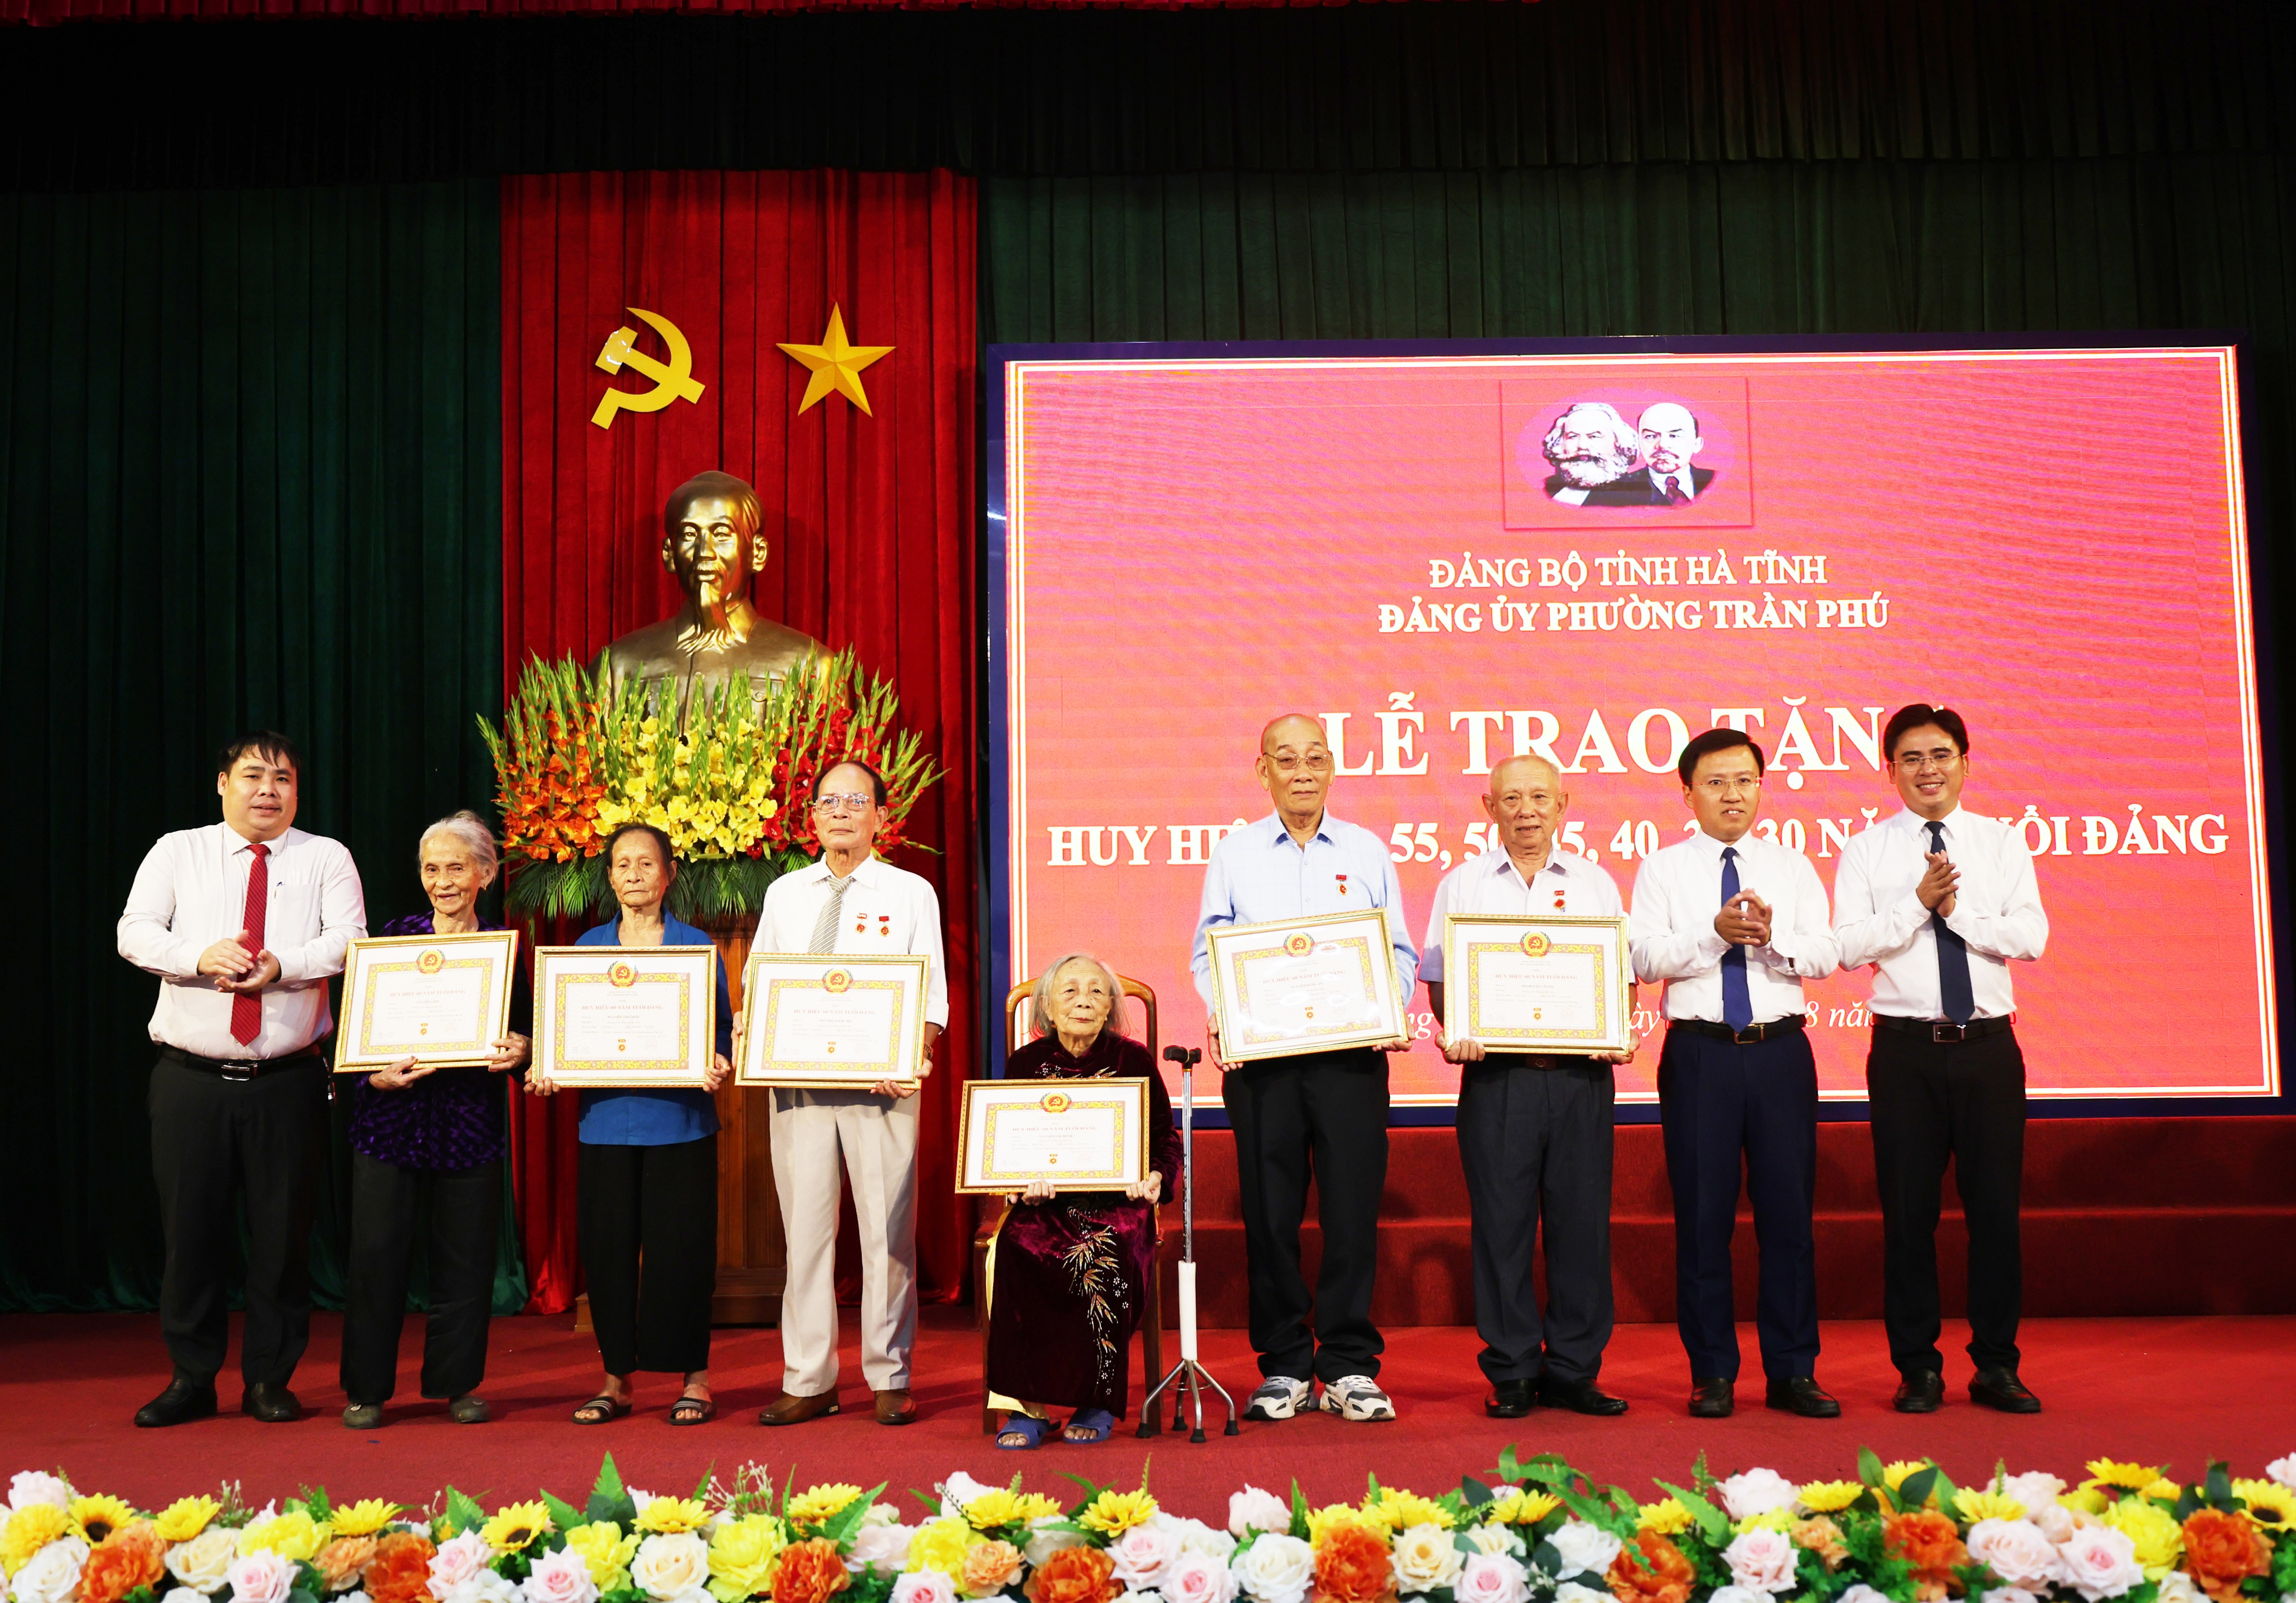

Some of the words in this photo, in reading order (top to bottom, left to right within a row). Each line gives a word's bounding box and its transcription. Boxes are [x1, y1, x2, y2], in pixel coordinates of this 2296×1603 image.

[1429, 551, 1531, 588] ĐẢNG
[1537, 550, 1588, 592] BỘ
[1595, 549, 1679, 586] TỈNH
[1685, 549, 1738, 585] HÀ
[1743, 549, 1828, 584] TĨNH
[1378, 595, 1483, 633] ĐẢNG
[1489, 595, 1540, 632] ỦY
[1546, 594, 1704, 631] PHƯỜNG
[1708, 592, 1808, 629] TRẦN
[1815, 591, 1890, 628] PHÚ
[1318, 691, 1428, 776] LỄ
[1450, 708, 1689, 774] TRAO
[1711, 696, 1944, 790] TẶN
[1047, 826, 1158, 866] HUY
[1390, 823, 1452, 870] 55,
[2081, 803, 2229, 855] ĐẢNG
